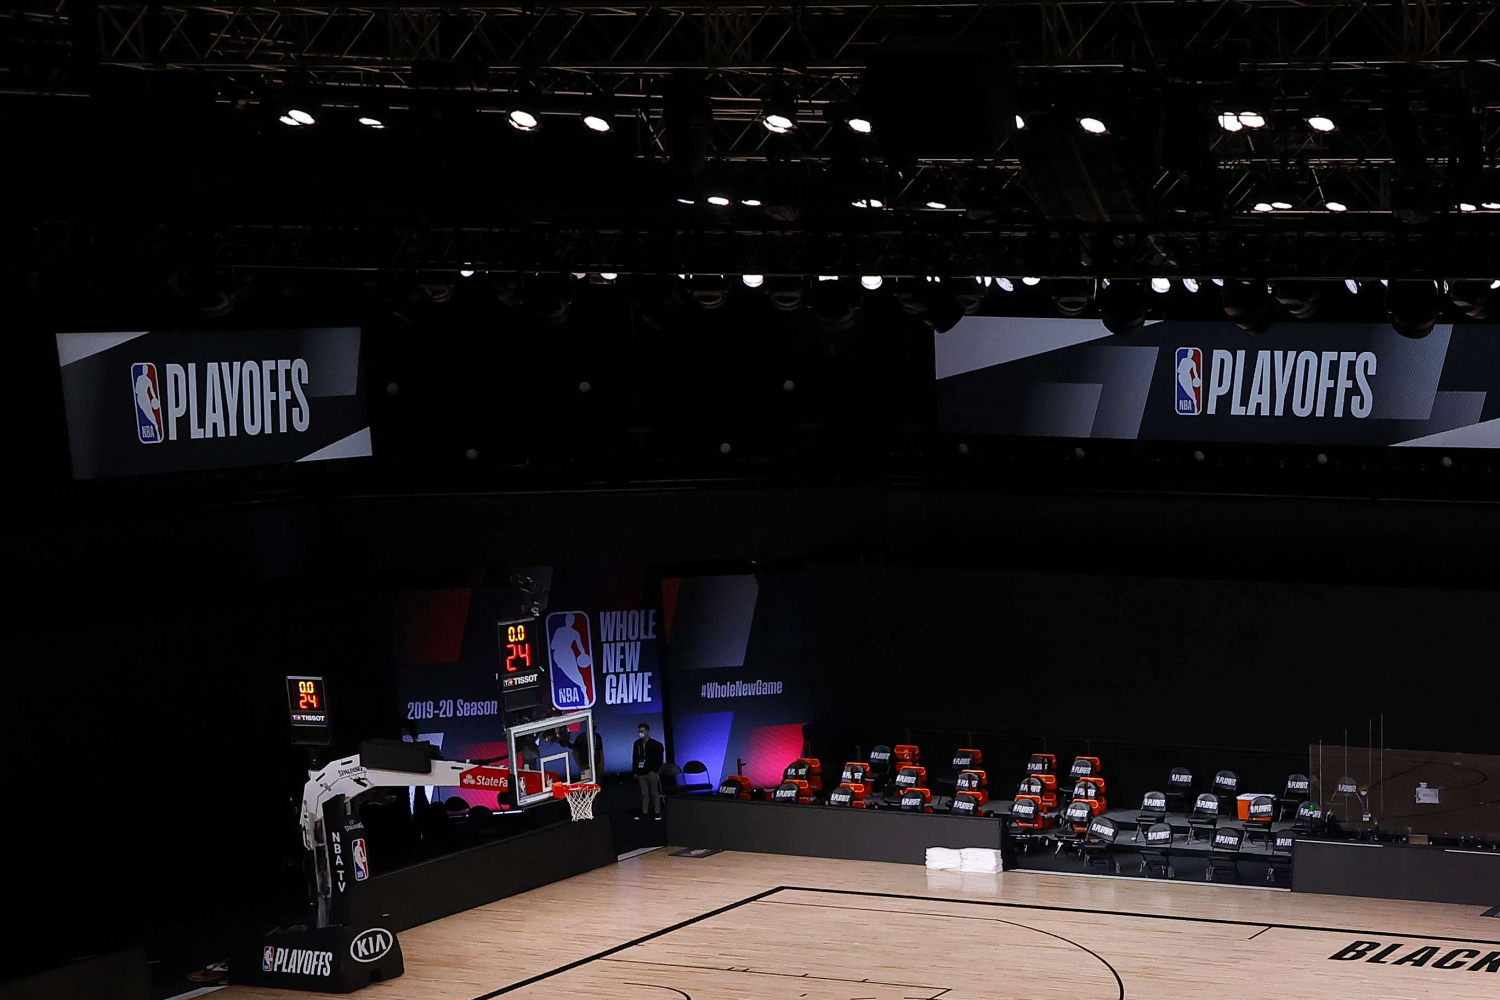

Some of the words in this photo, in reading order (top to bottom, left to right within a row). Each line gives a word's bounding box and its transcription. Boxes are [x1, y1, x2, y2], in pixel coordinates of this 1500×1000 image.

[1206, 349, 1378, 419] PLAYOFFS
[166, 358, 310, 441] PLAYOFFS
[1179, 400, 1193, 411] NBA
[142, 425, 155, 439] NBA
[508, 624, 525, 642] 0.0
[600, 609, 657, 642] WHOLE
[506, 643, 532, 672] 24
[602, 641, 641, 673] NEW
[514, 673, 539, 686] TISSOT
[605, 672, 652, 705] GAME
[701, 679, 783, 699] #WholeNewGame
[299, 694, 318, 709] 24
[559, 687, 580, 704] NBA
[407, 699, 454, 720] 2019-20
[456, 699, 498, 717] Season
[476, 775, 508, 788] StateFa
[332, 832, 344, 866] NBA
[337, 870, 346, 892] TV
[356, 933, 387, 957] KIA
[273, 947, 332, 976] PLAYOFFS
